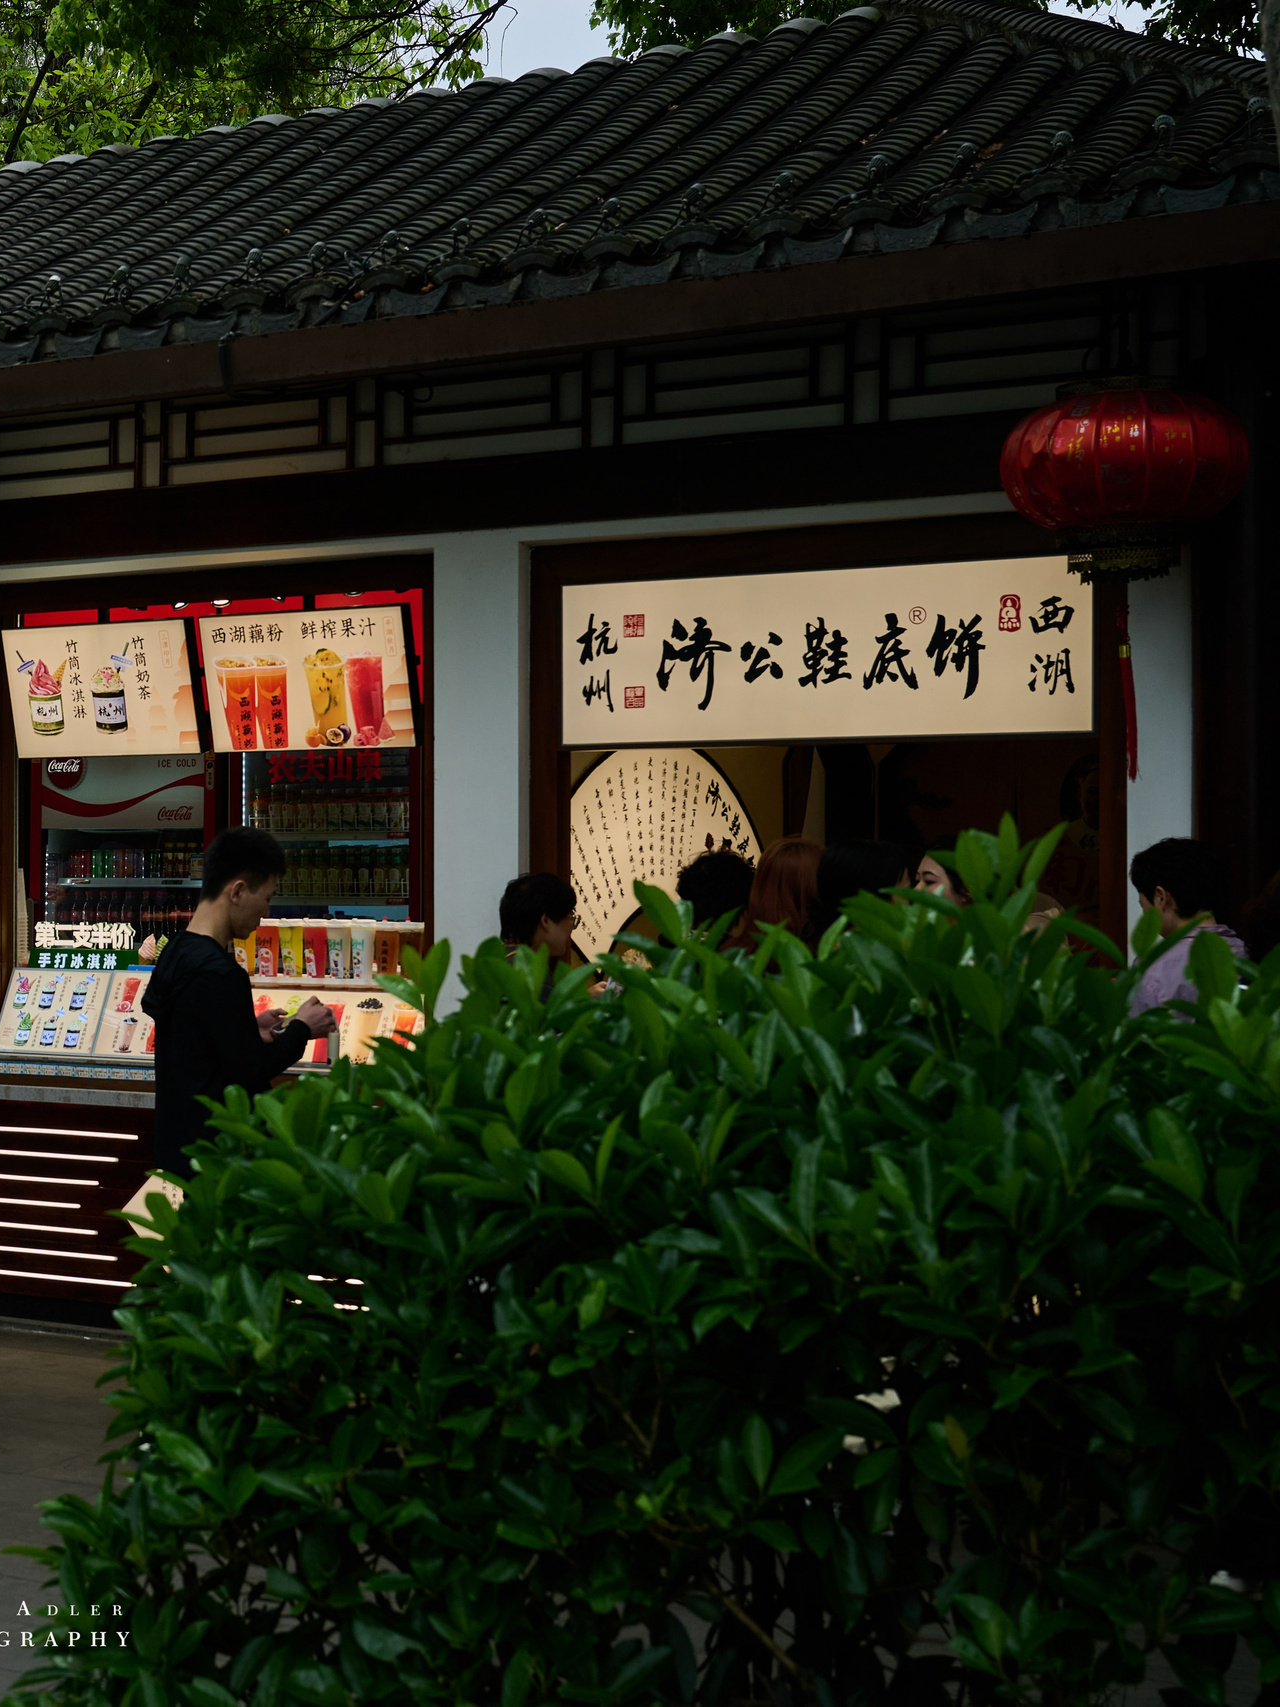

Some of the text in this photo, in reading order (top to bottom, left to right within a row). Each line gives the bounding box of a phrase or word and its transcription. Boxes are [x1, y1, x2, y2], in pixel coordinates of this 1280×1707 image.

[211, 617, 376, 645] 西湖藕粉 鲜榨果汁
[1028, 595, 1075, 696] 西湖
[65, 639, 87, 719] 竹筒冰淇淋
[131, 635, 152, 701] 竹筒奶茶
[576, 613, 618, 713] 杭州
[157, 758, 197, 768] ICE COLD
[268, 748, 383, 784] 农夫山泉
[34, 921, 137, 950] 第二支半价
[38, 952, 118, 970] 手打冰淇淋
